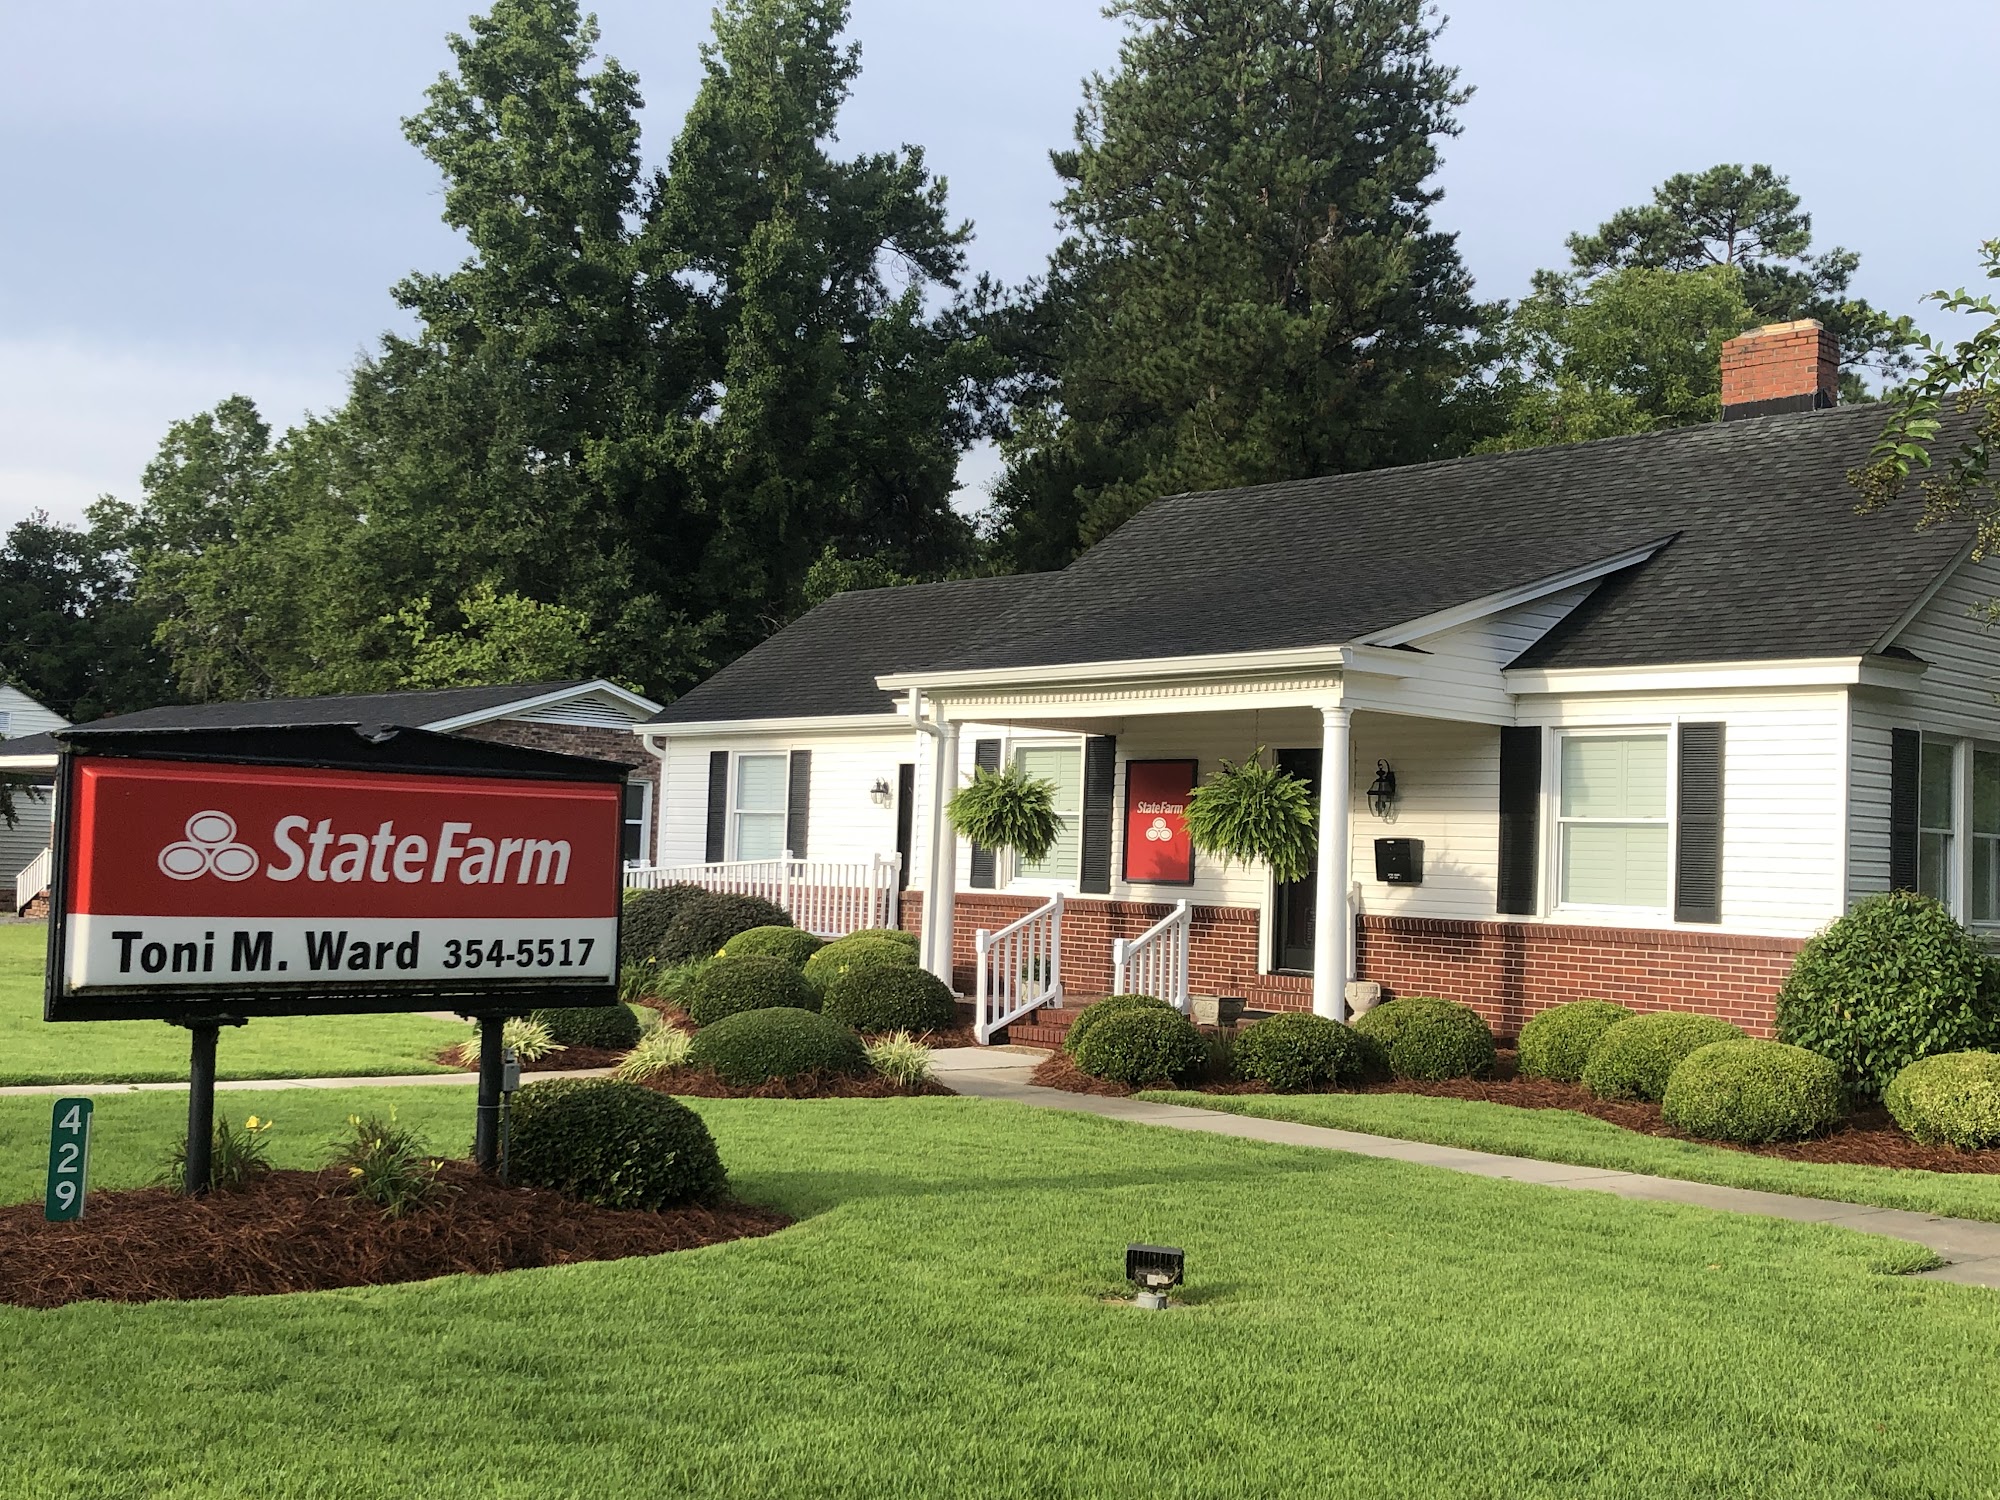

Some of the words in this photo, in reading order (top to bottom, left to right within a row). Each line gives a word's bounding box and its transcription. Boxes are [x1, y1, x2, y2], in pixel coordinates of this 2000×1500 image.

[112, 931, 215, 973] Toni
[231, 931, 288, 972] M.
[305, 930, 420, 971] Ward
[442, 938, 595, 969] 354-5517
[55, 1104, 82, 1211] 429
